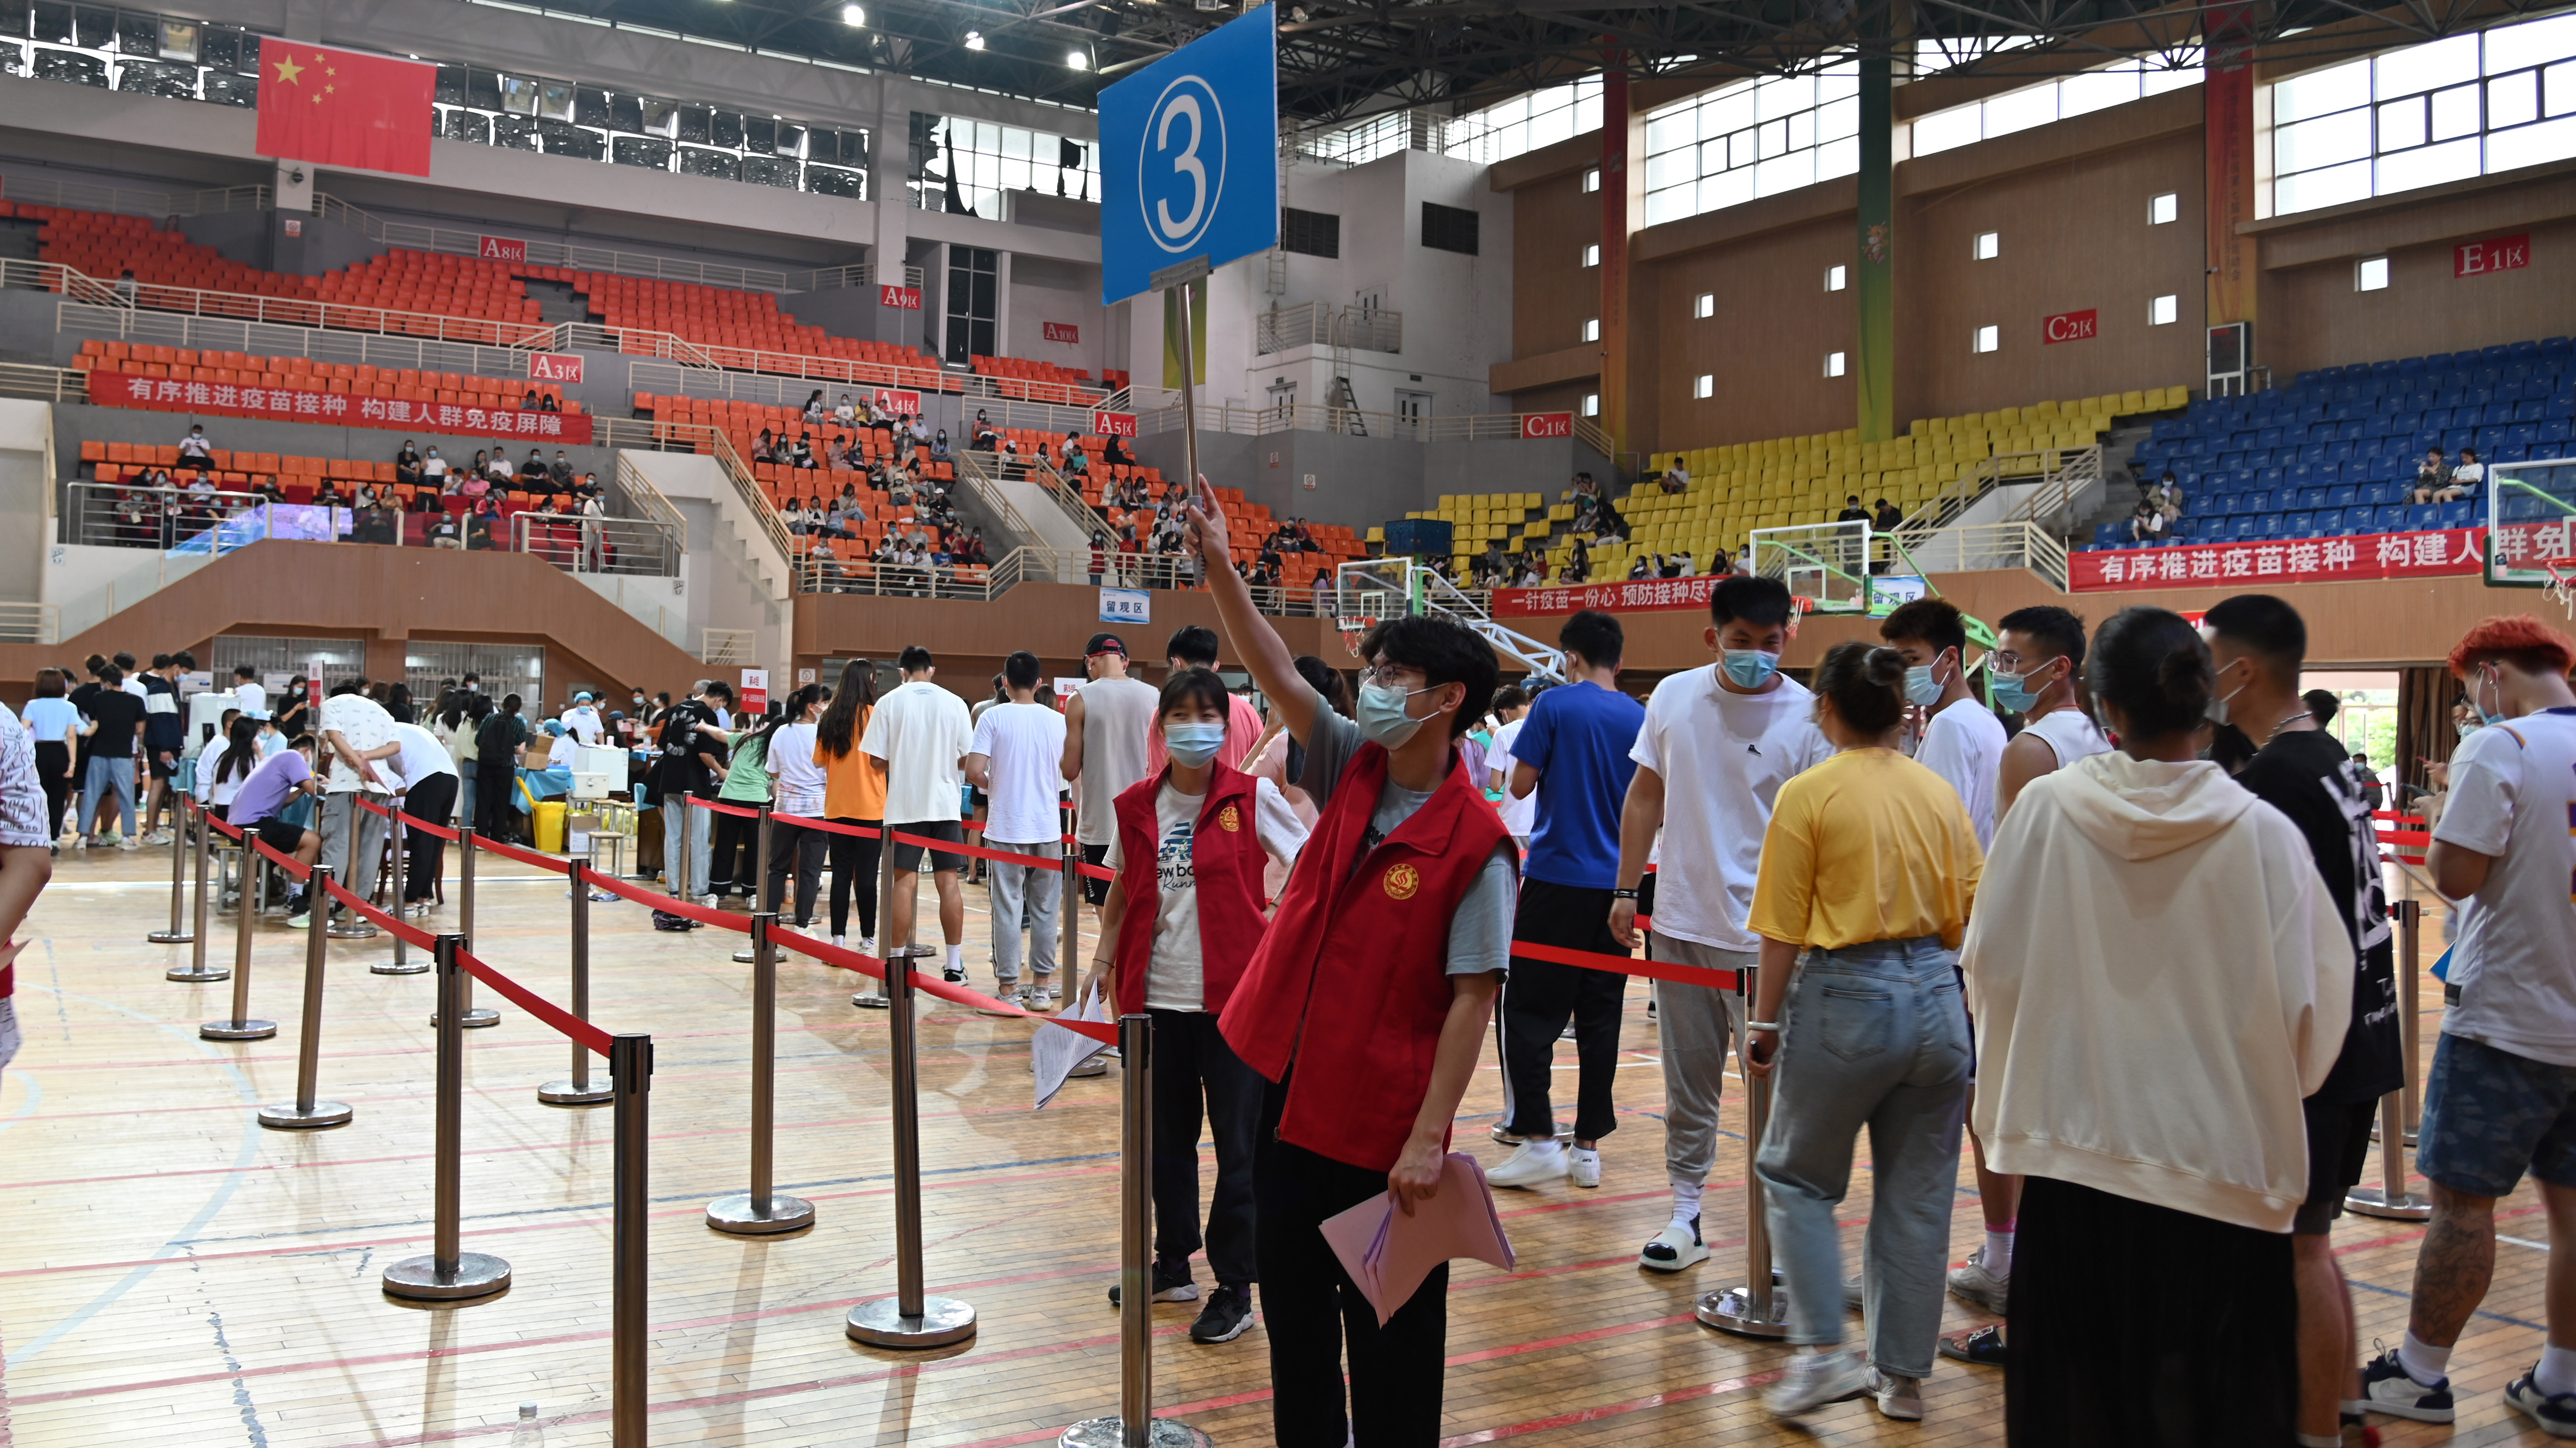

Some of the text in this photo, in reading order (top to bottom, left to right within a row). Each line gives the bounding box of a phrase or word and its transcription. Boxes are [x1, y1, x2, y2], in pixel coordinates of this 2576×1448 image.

[484, 239, 522, 261] A8区
[1046, 323, 1077, 342] A10区
[2048, 316, 2093, 341] C2区
[533, 355, 579, 381] A3区
[128, 377, 562, 436] 有序推进疫苗接种 构建人群免疫屏障
[1098, 413, 1133, 435] A5区
[1527, 416, 1567, 436] C1区
[2099, 525, 2576, 584] 有序推进疫苗接种 构建人群免
[1106, 601, 1143, 614] 留观区
[1511, 587, 1616, 611] 一针疫苗一份心
